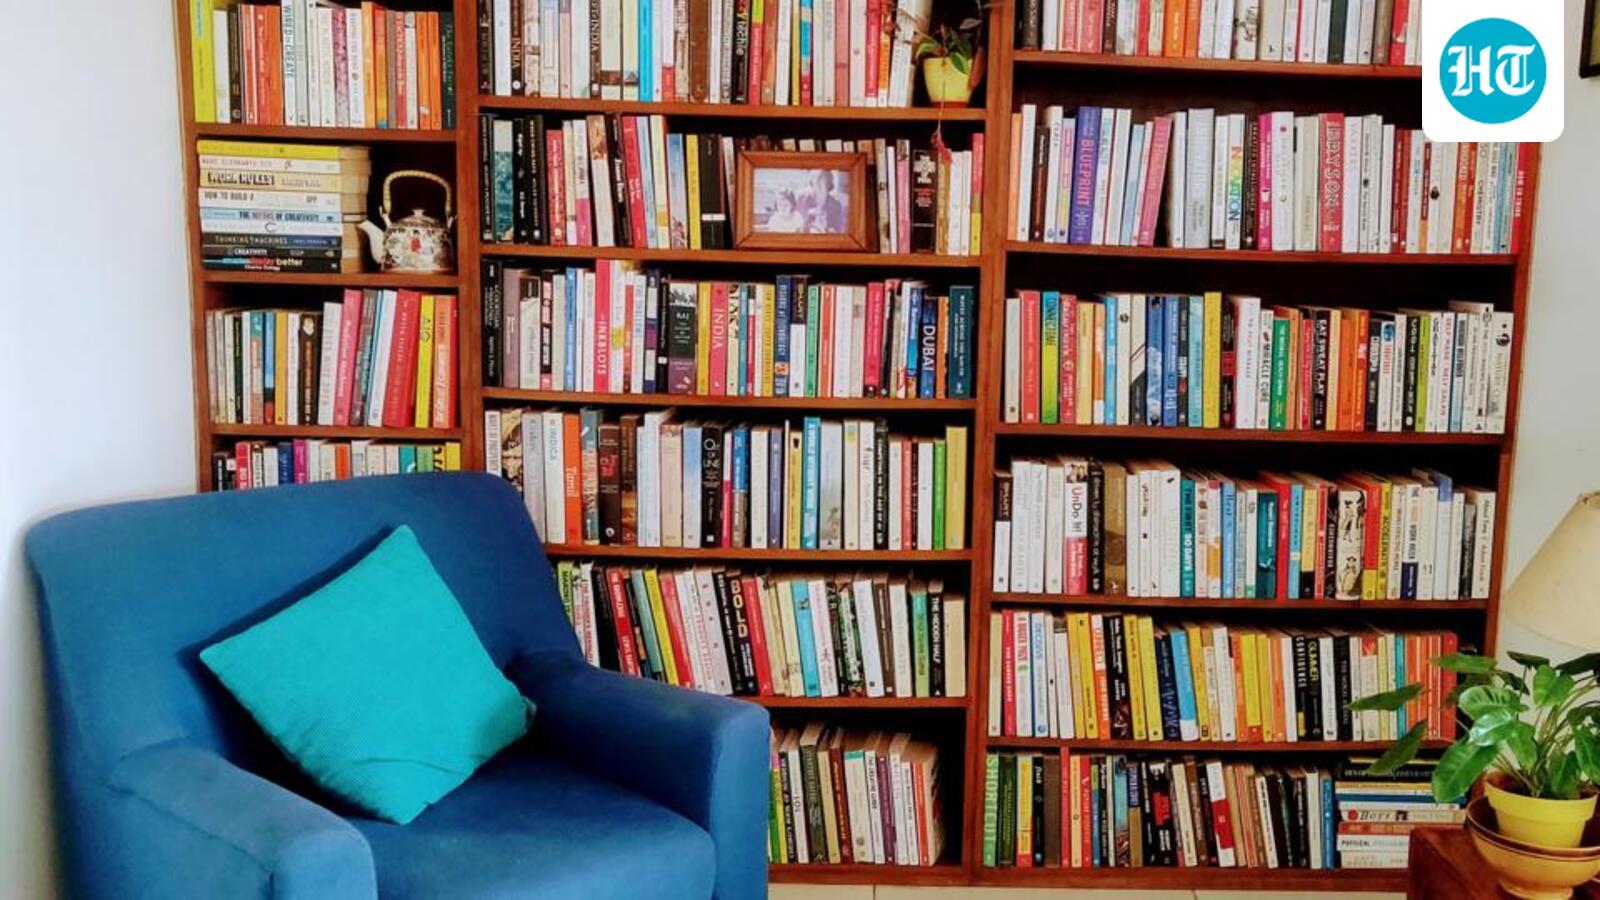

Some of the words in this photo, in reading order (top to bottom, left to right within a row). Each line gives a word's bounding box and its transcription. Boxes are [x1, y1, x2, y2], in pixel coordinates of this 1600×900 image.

[591, 19, 600, 51] INDIA
[512, 37, 521, 68] INDIA
[1077, 138, 1093, 207] BLUEPRINT
[230, 192, 247, 201] BUILD
[239, 211, 249, 219] THE
[275, 258, 303, 267] better
[712, 308, 724, 350] INDIA
[1319, 319, 1327, 336] EAT
[598, 320, 607, 375] INKBLOTS
[923, 325, 936, 371] DUBAI
[1261, 344, 1271, 378] MIRACLE
[1317, 339, 1326, 369] SWEAT
[1260, 381, 1269, 403] CURE
[1316, 373, 1325, 395] PLAY
[549, 428, 558, 461] INDICA
[566, 466, 579, 497] Tamil
[1184, 488, 1192, 505] THE
[1072, 487, 1084, 518] UnDo
[1074, 521, 1083, 532] It!
[1184, 548, 1192, 571] DAYS
[611, 573, 619, 582] THE
[730, 580, 748, 638] BOLD
[932, 597, 940, 612] THE
[933, 644, 941, 663] HALF
[1296, 636, 1307, 688] CONFIDENCE
[984, 758, 999, 842] SHORTCUT
